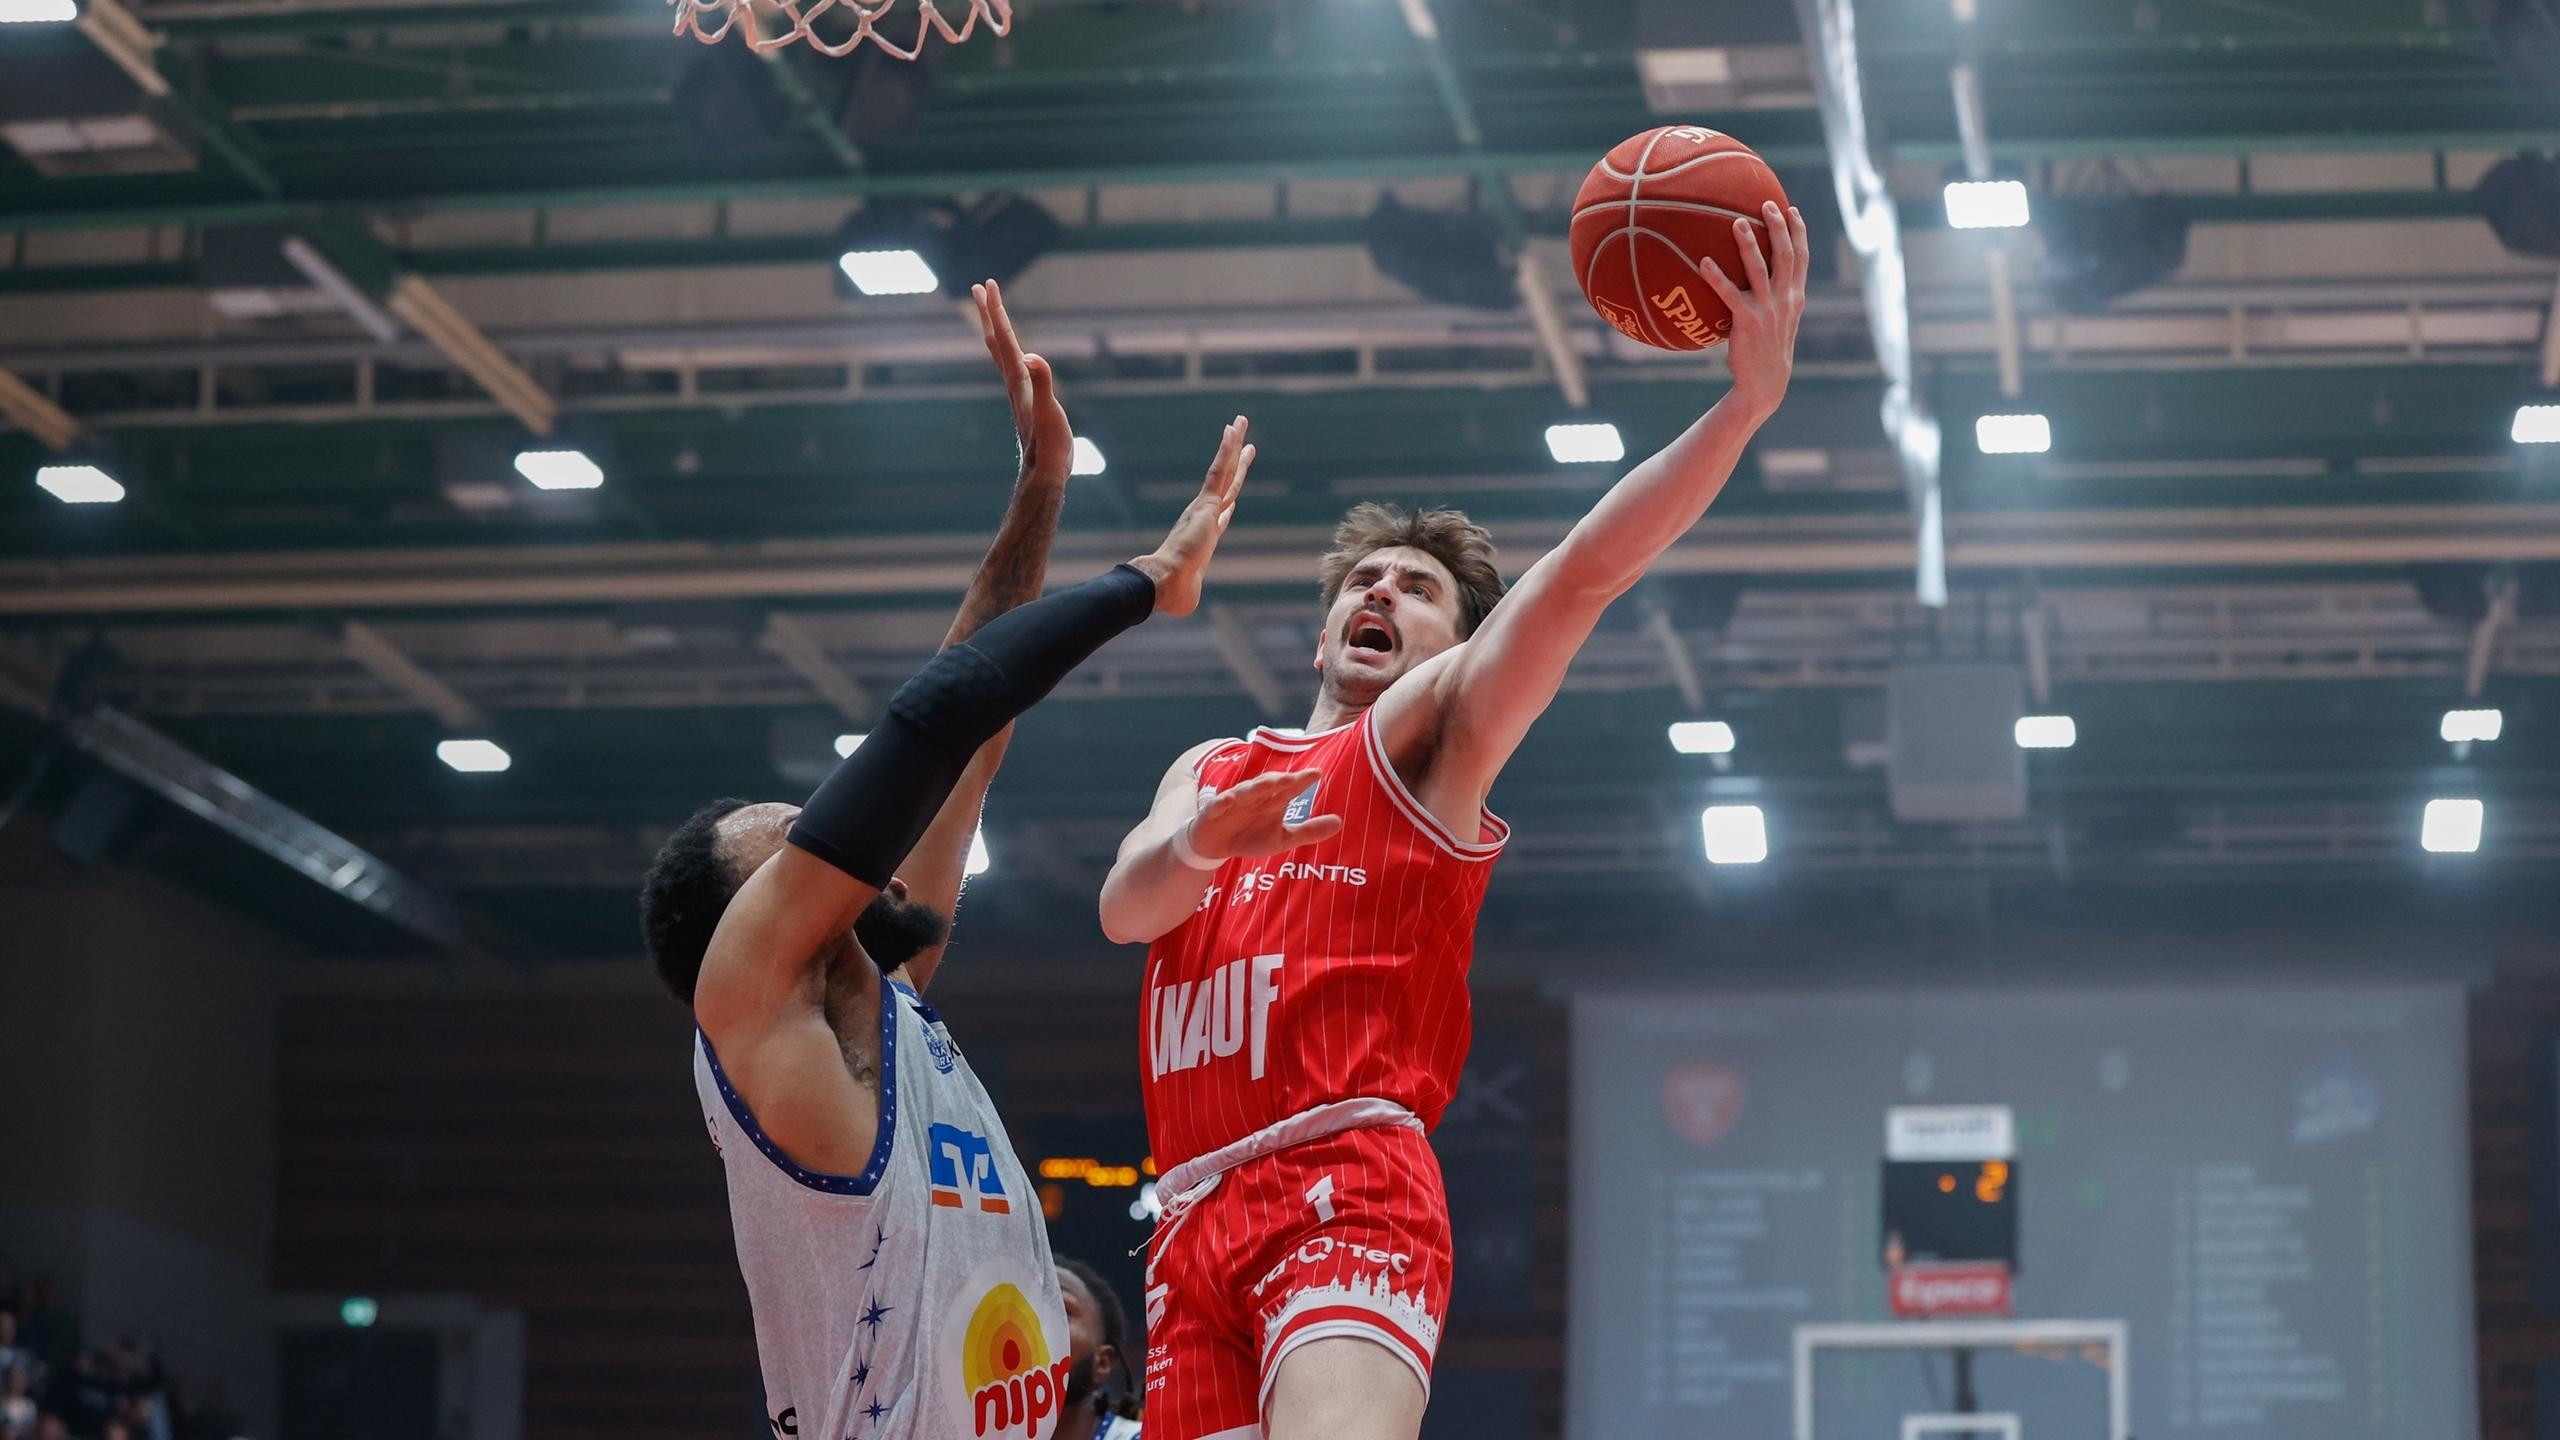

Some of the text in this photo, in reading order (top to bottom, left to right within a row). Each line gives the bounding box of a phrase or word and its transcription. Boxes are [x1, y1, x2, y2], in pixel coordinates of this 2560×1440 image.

[1651, 286, 1724, 348] SPALD
[1257, 861, 1367, 892] SRINTIS
[1306, 1174, 1336, 1224] 1
